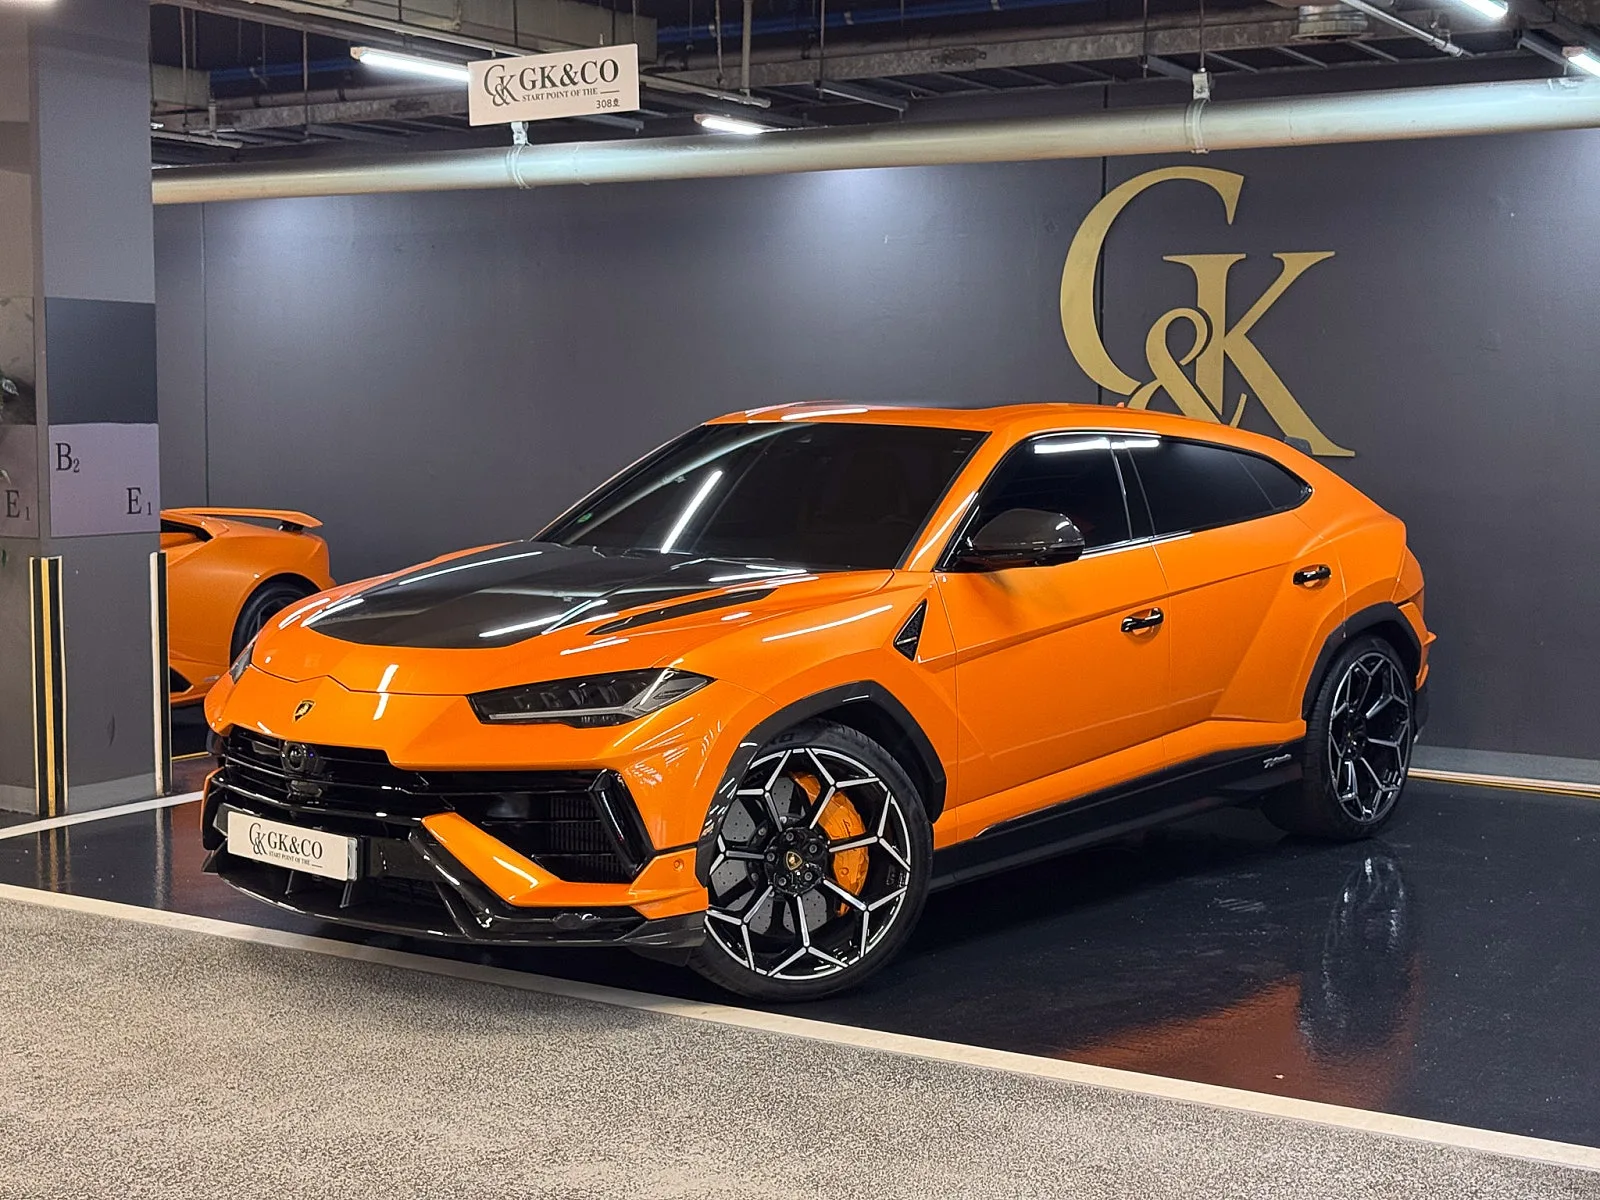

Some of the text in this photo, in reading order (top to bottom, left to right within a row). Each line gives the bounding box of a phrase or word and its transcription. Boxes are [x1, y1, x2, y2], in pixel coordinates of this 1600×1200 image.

[519, 58, 619, 91] GK&CO
[522, 87, 599, 102] START POINT OF THE
[267, 831, 323, 860] GK&CO
[269, 851, 281, 859] START
[281, 854, 295, 862] POINT
